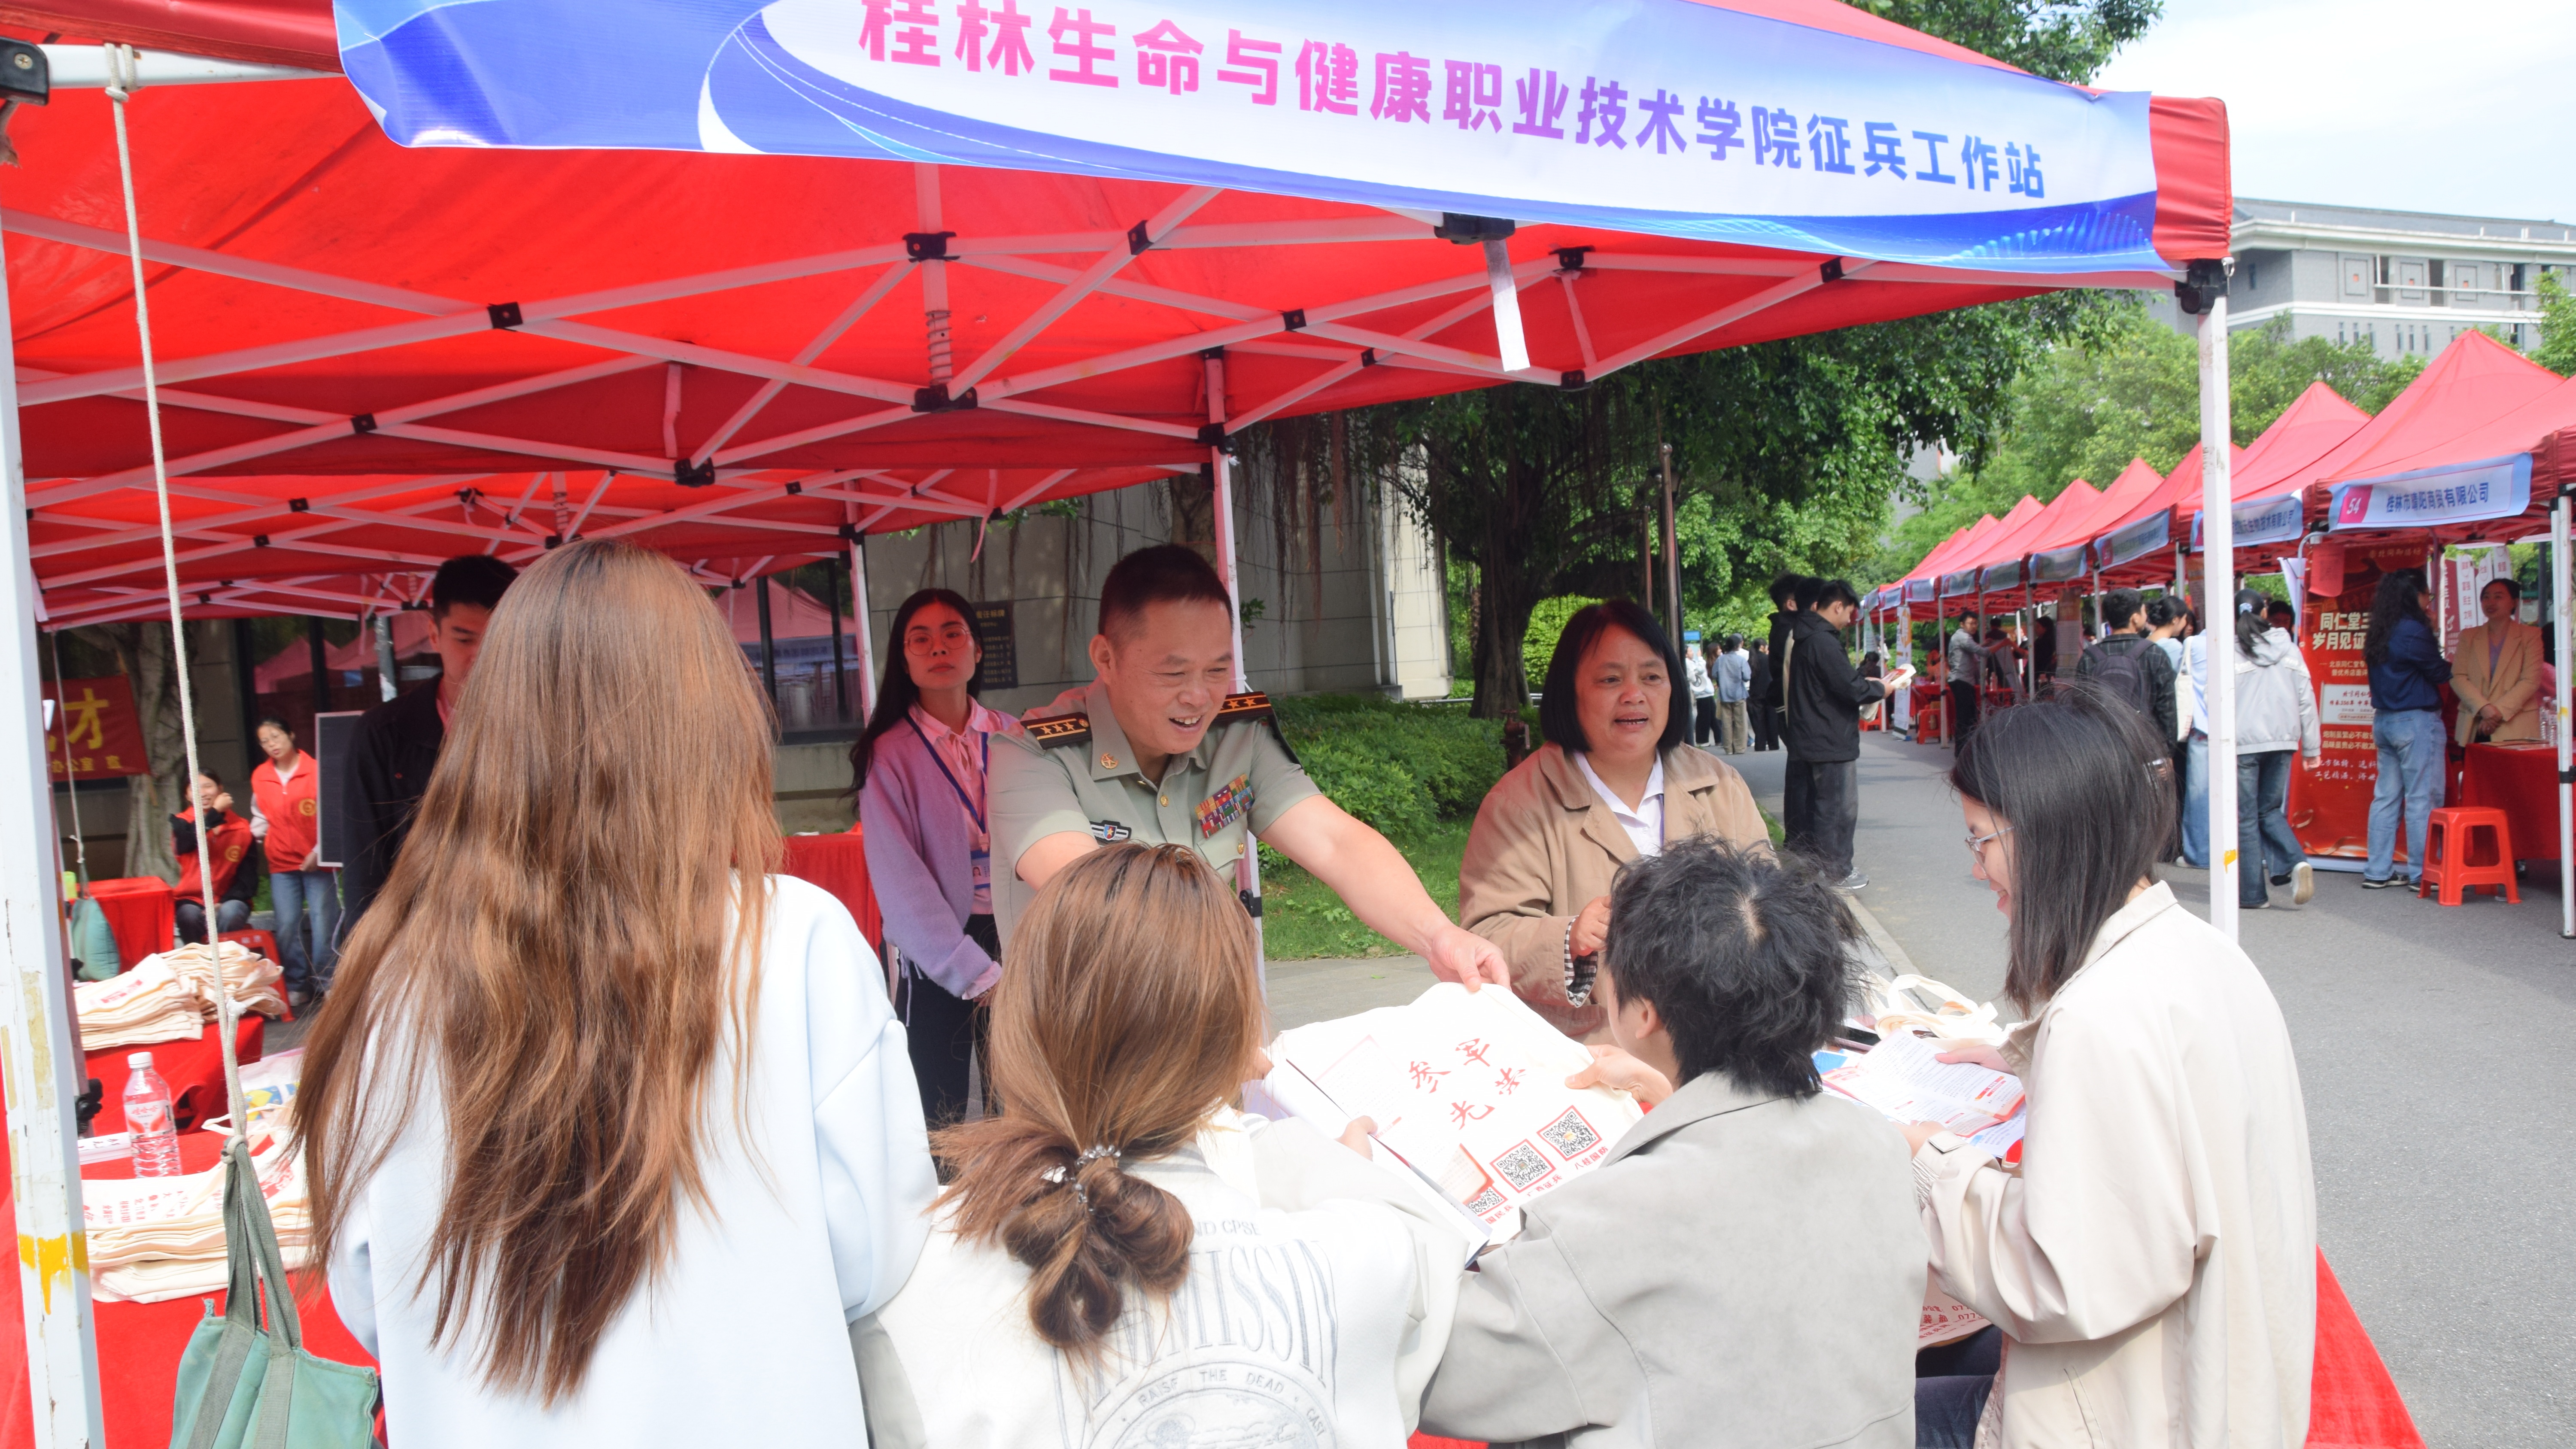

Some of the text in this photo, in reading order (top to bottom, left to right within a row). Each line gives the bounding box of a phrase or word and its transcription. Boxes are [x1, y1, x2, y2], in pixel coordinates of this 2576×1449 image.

[858, 0, 2046, 199] 桂林生命与健康职业技术学院征兵工作站
[2346, 498, 2361, 515] 54
[2312, 632, 2366, 650] 岁月见证
[1574, 1145, 1609, 1170] 八桂国防
[1526, 1173, 1563, 1197] 广西征兵
[1199, 1368, 1228, 1383] THE
[1245, 1371, 1285, 1395] DEAD
